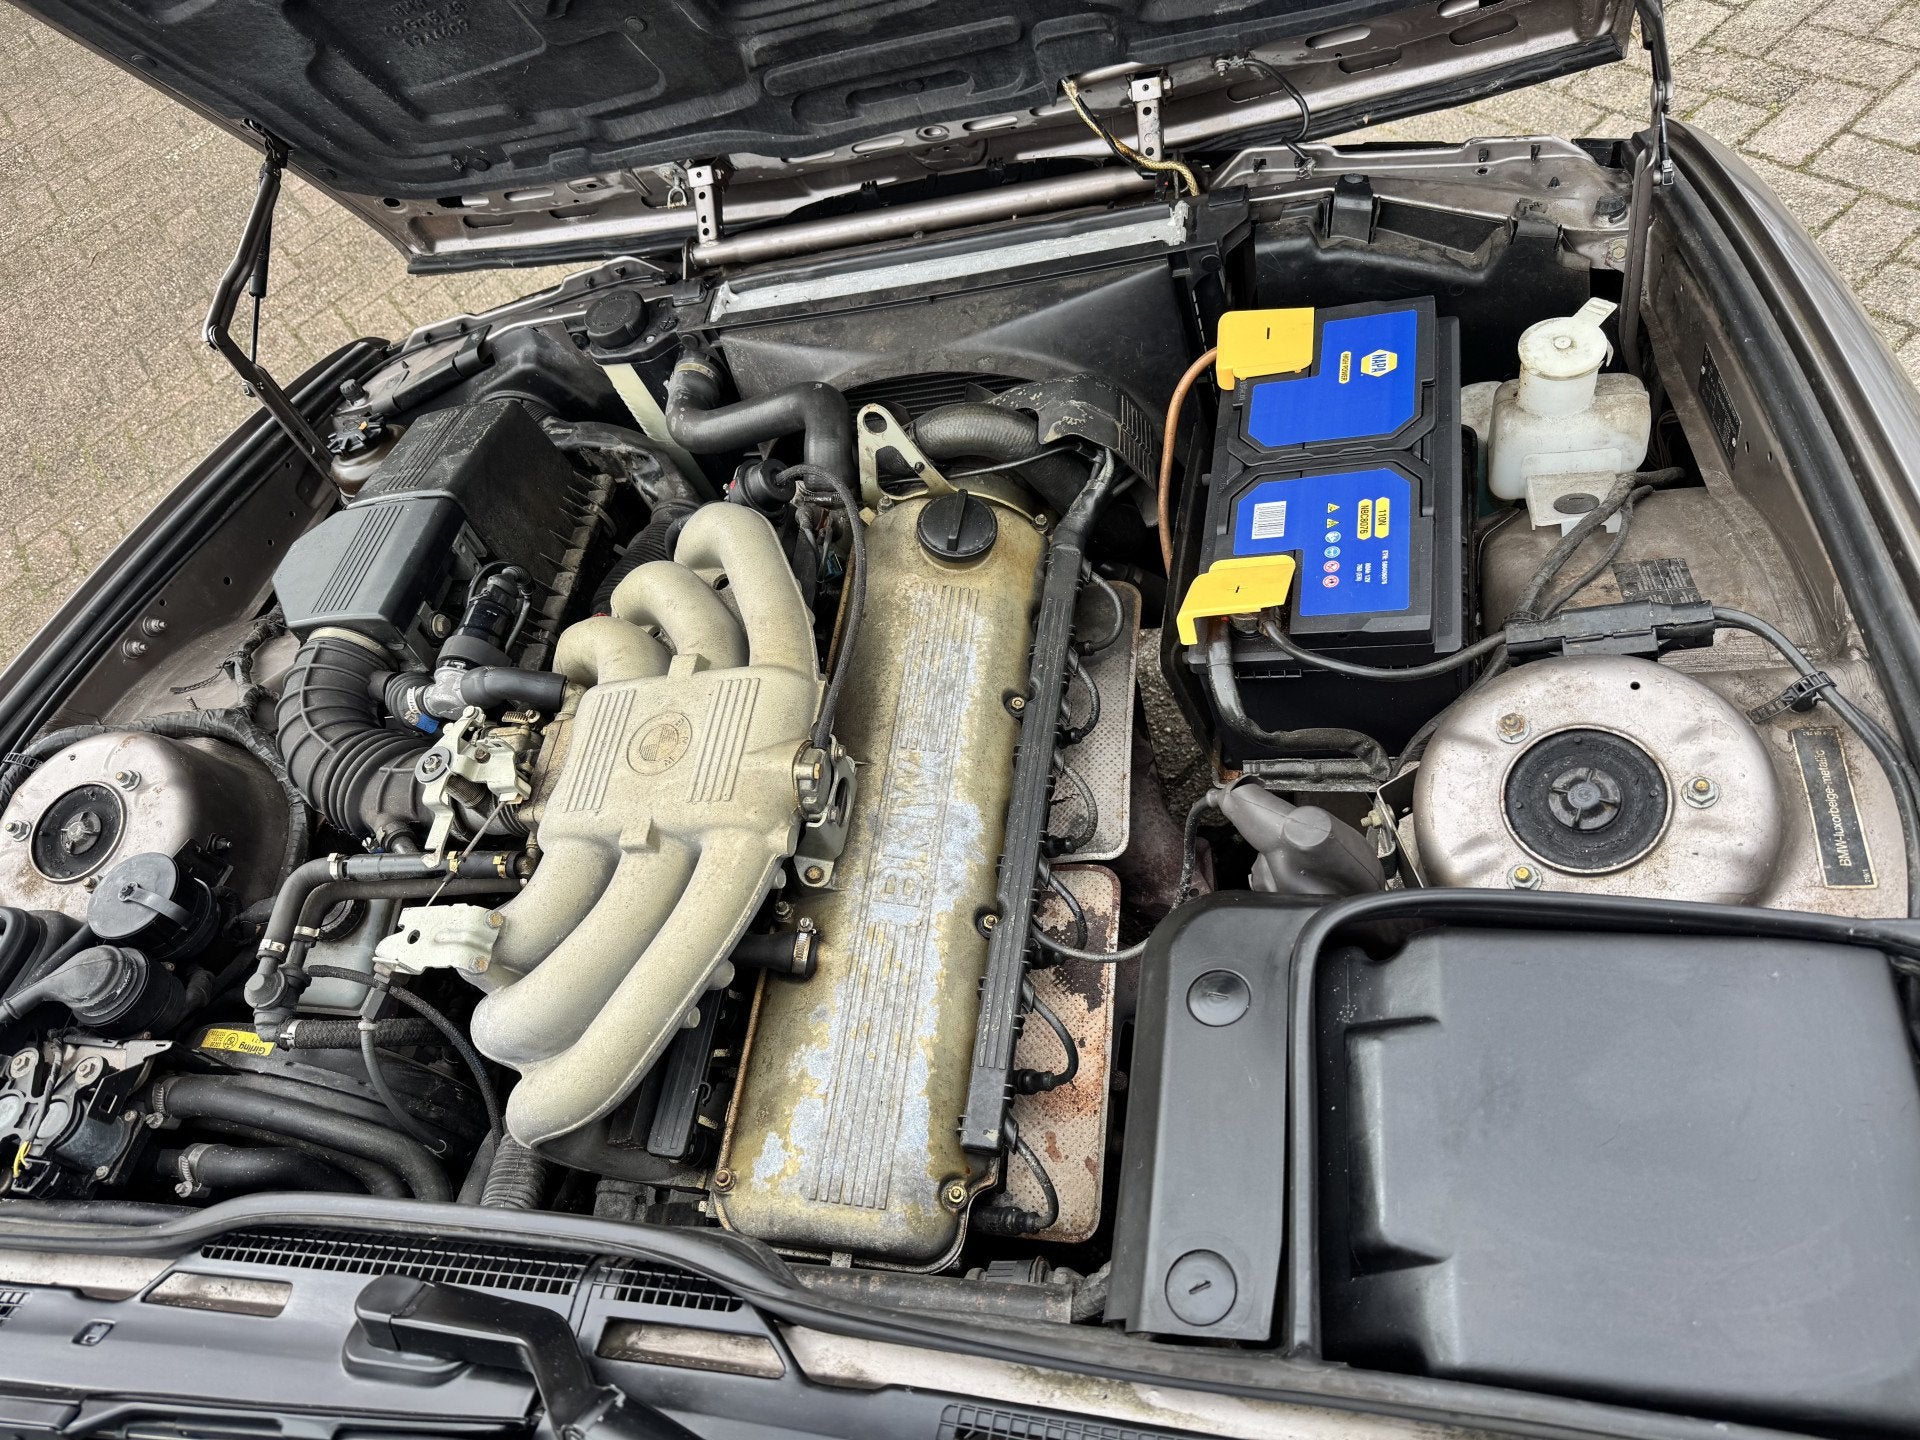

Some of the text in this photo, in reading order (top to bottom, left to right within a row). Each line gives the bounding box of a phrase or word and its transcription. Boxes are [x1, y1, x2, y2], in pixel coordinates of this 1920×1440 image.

[1341, 353, 1350, 381] HIGH POWER
[1371, 353, 1387, 373] NAPA
[1378, 509, 1387, 526] 110N
[875, 753, 943, 907] BMW
[238, 1041, 266, 1055] Girling
